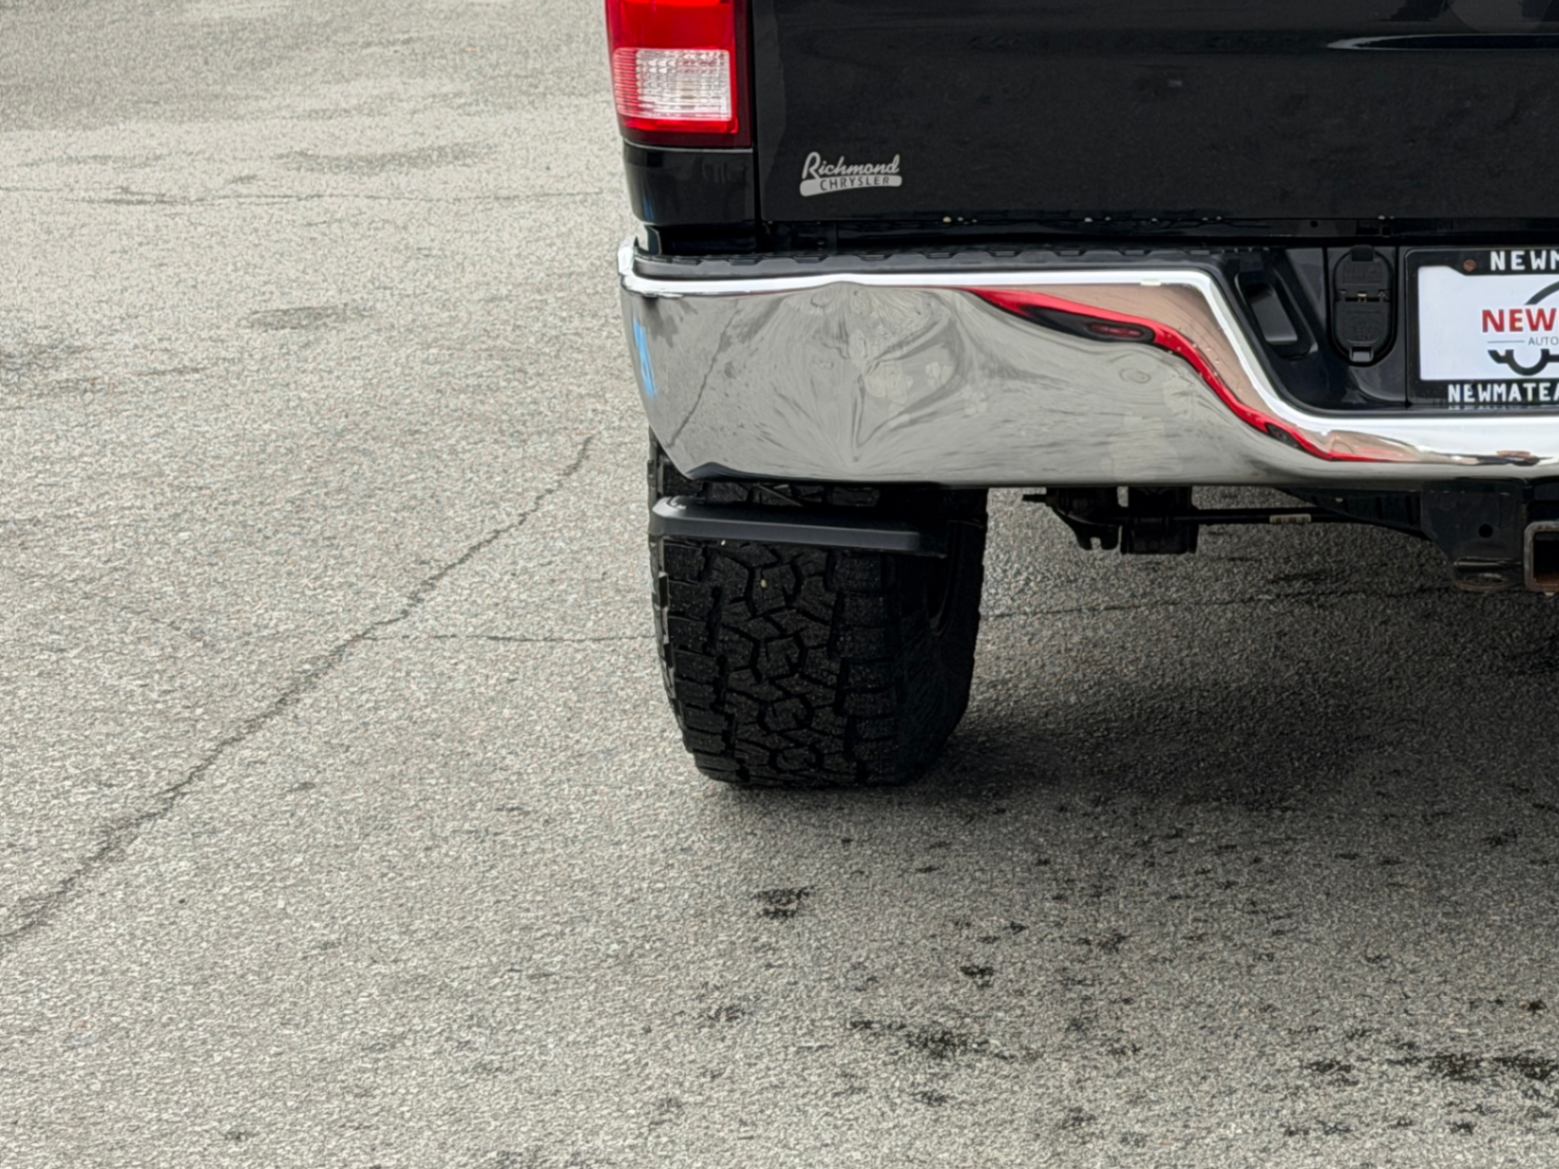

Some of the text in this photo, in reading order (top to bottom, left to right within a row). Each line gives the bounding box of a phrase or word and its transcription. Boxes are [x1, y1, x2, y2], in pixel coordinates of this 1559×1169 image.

[802, 152, 900, 179] Richmond
[819, 177, 891, 191] CHRYSLER
[1528, 336, 1559, 346] AUTO
